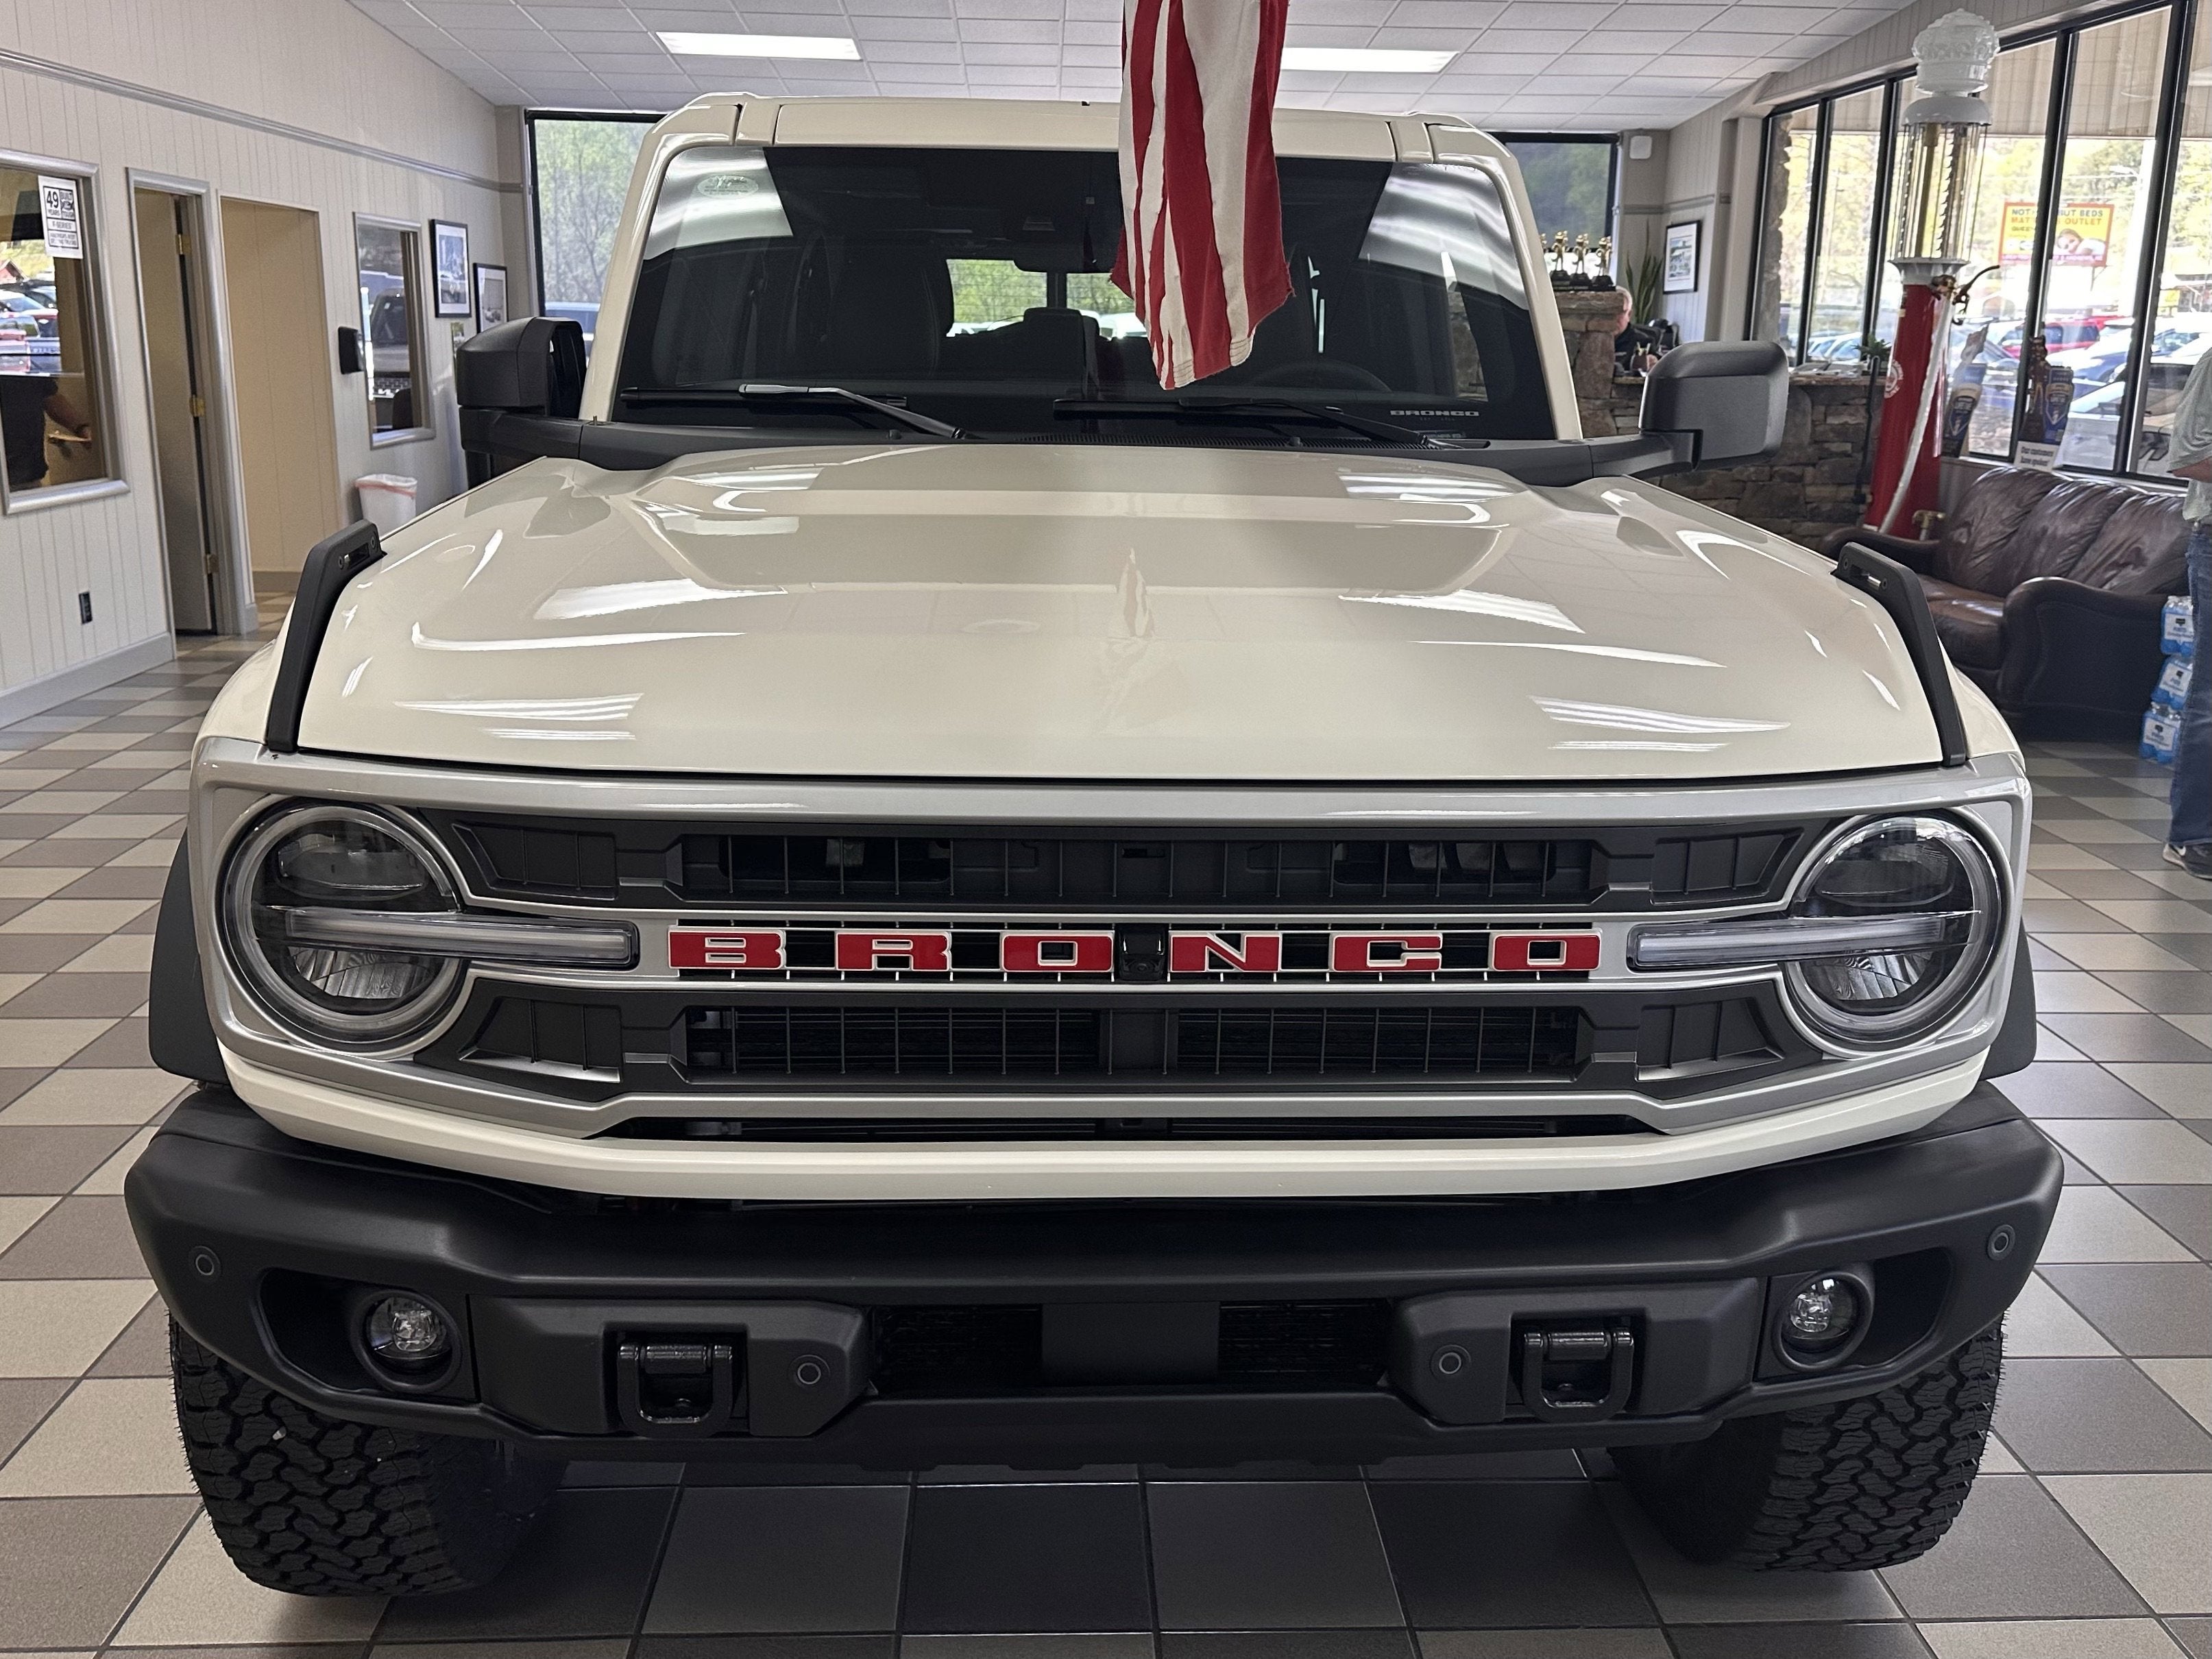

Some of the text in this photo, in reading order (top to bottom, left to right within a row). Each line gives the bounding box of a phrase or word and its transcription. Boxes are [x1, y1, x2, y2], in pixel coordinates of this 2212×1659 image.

[47, 191, 58, 208] 49
[2065, 217, 2102, 226] OUTLET
[668, 927, 1601, 973] BRONCO
